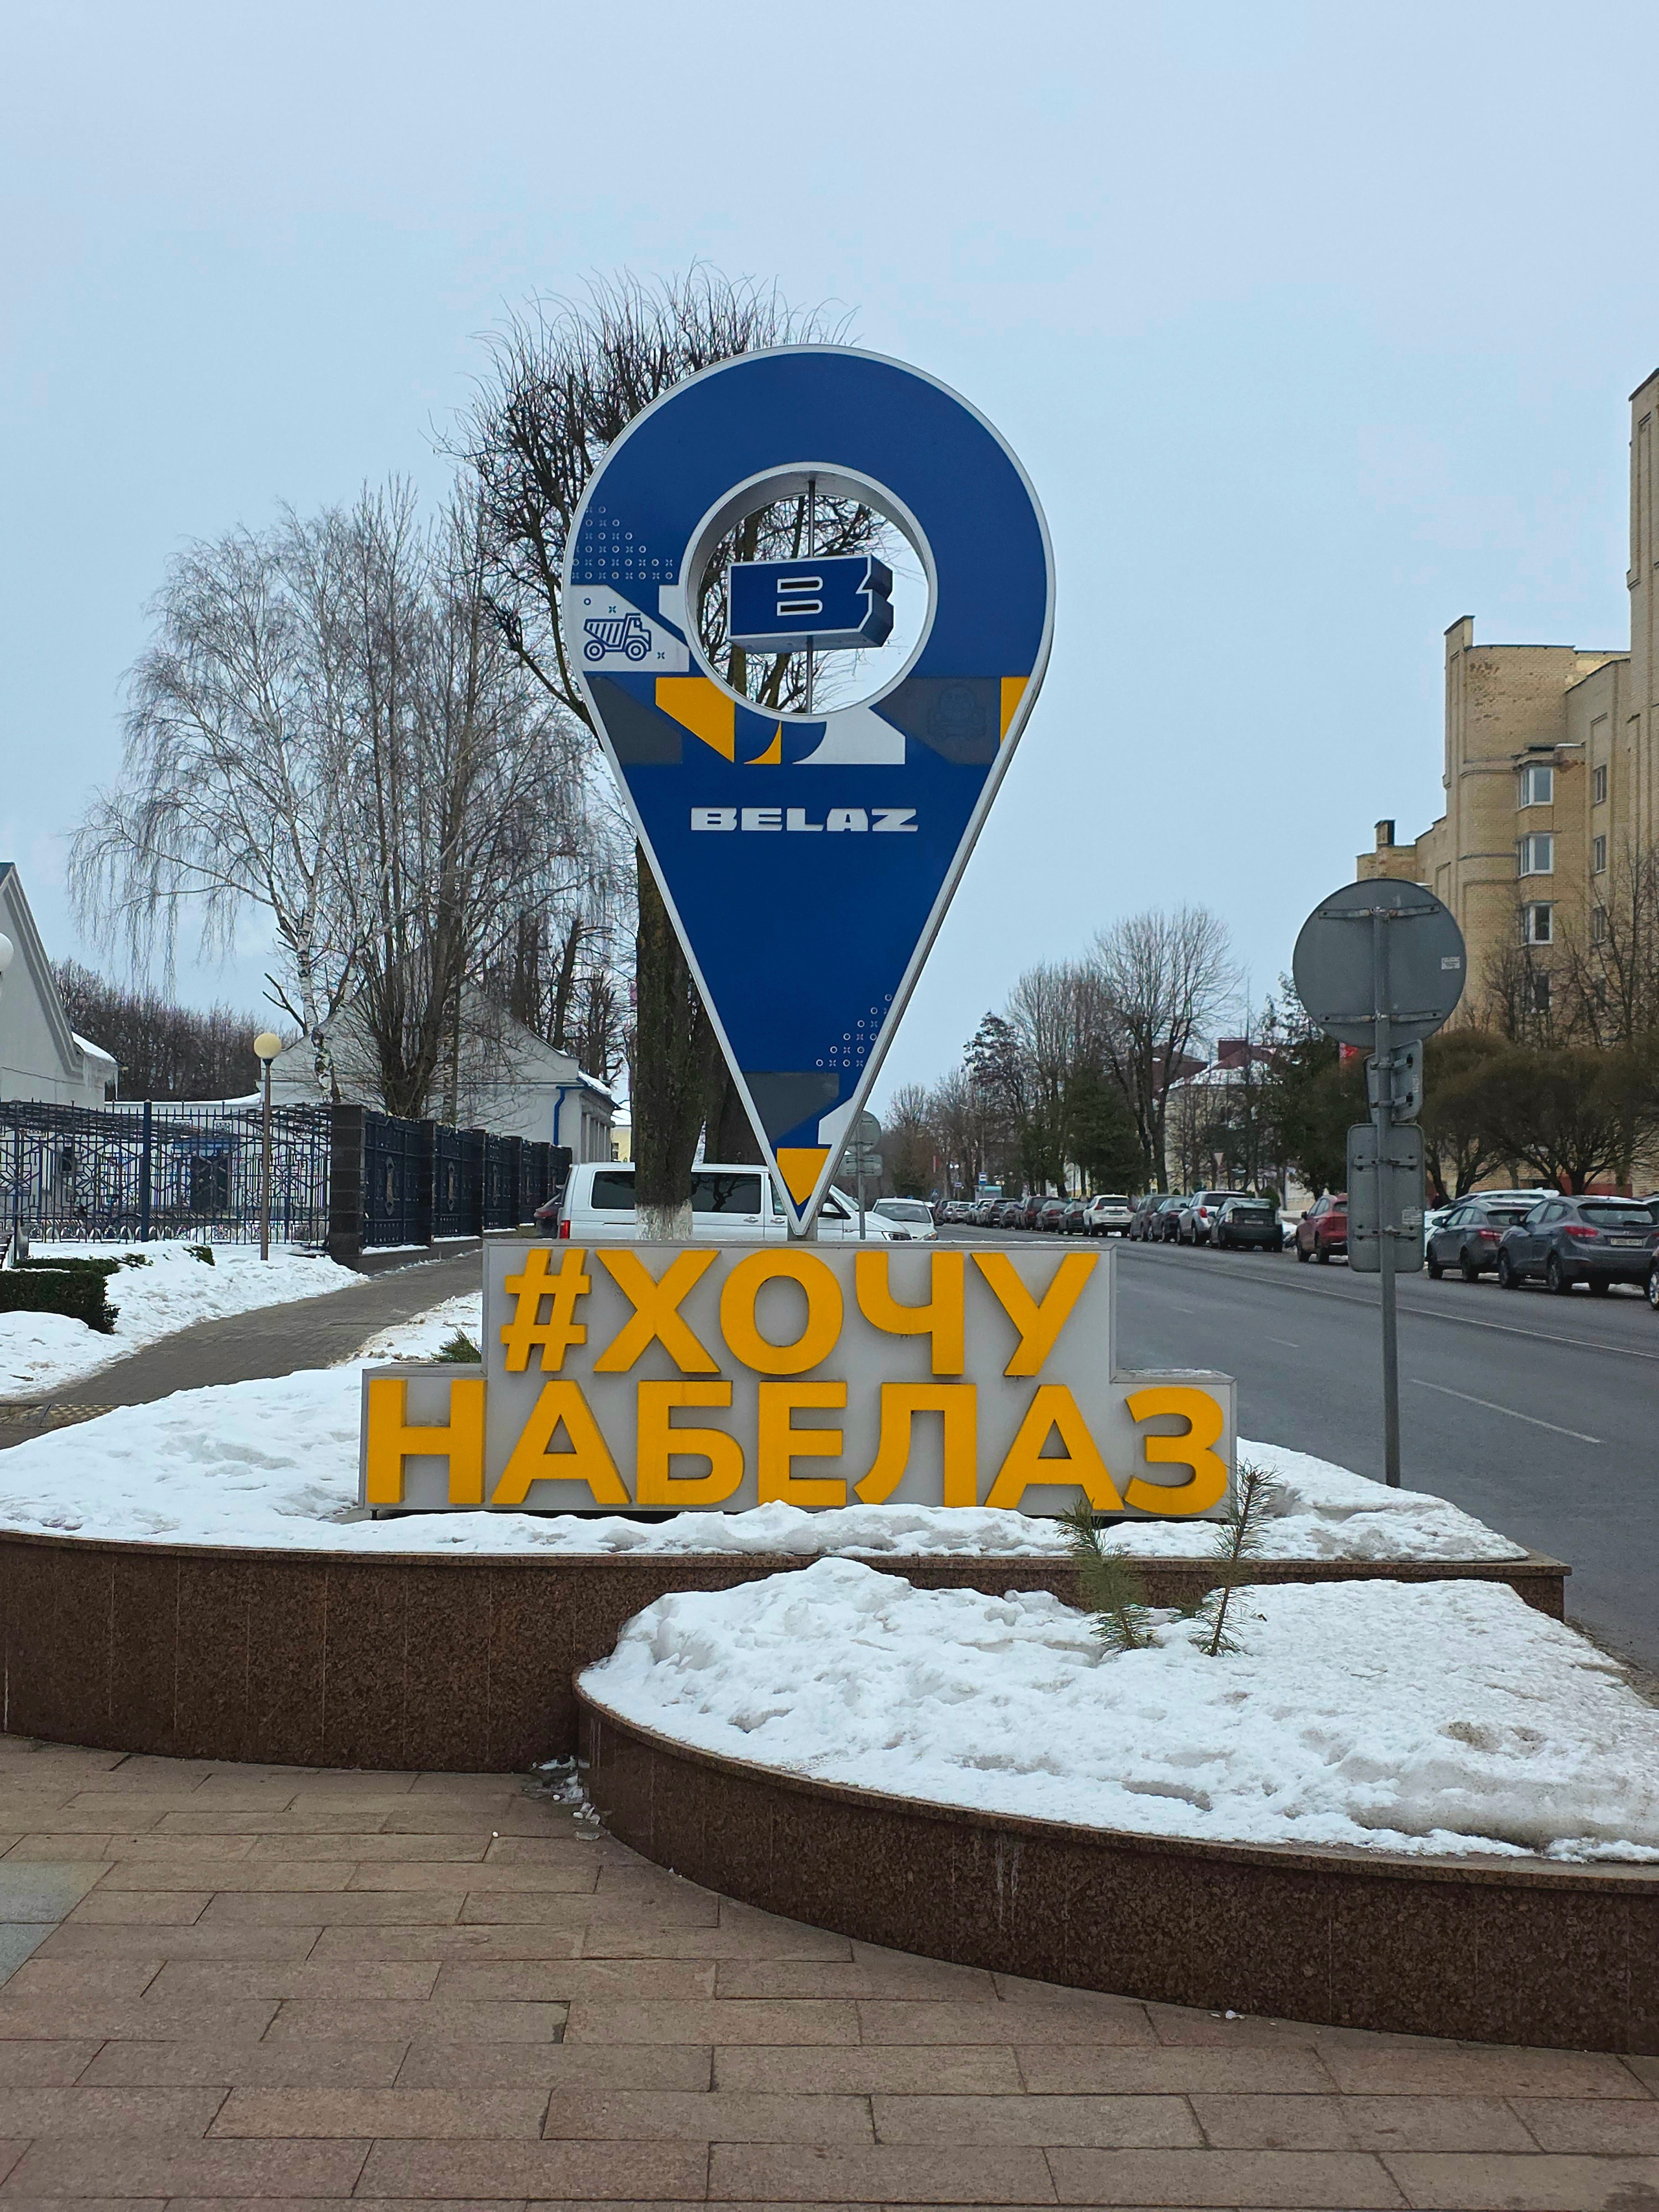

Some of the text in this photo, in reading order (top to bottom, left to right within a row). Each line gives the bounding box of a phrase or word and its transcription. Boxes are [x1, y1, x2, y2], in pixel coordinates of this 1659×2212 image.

[691, 808, 918, 832] BELAZ
[500, 1248, 1099, 1376] #ХОЧУ
[367, 1379, 1227, 1515] НАБЕЛАЗ
